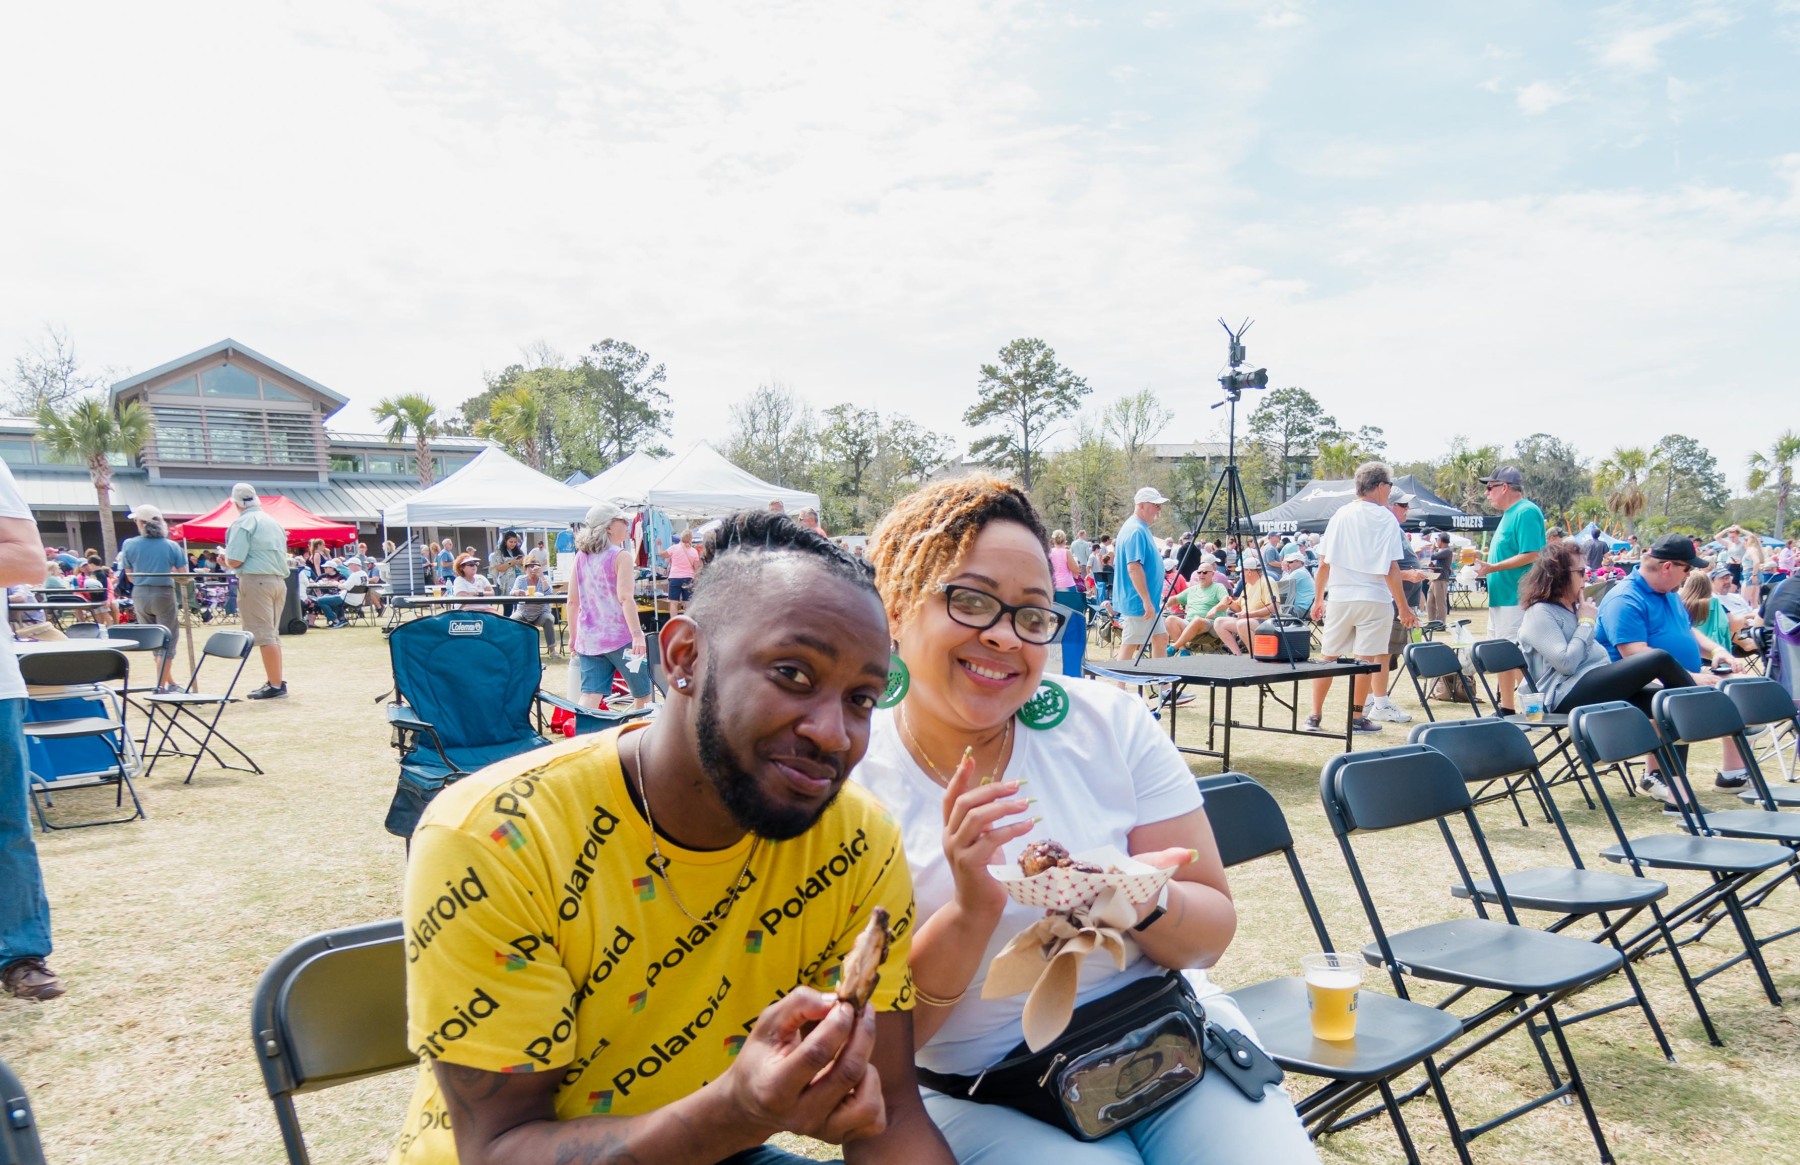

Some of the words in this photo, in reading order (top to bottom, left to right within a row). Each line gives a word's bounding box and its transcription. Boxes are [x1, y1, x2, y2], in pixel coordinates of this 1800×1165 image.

[1259, 520, 1299, 533] TICKETS
[1452, 516, 1484, 528] TICKETS
[407, 866, 489, 964] olaroid
[558, 805, 621, 927] olaroid
[759, 828, 869, 936] Polaroid
[646, 868, 757, 988] Polaroid
[416, 987, 500, 1060] aroid
[612, 974, 732, 1097] Polaroid
